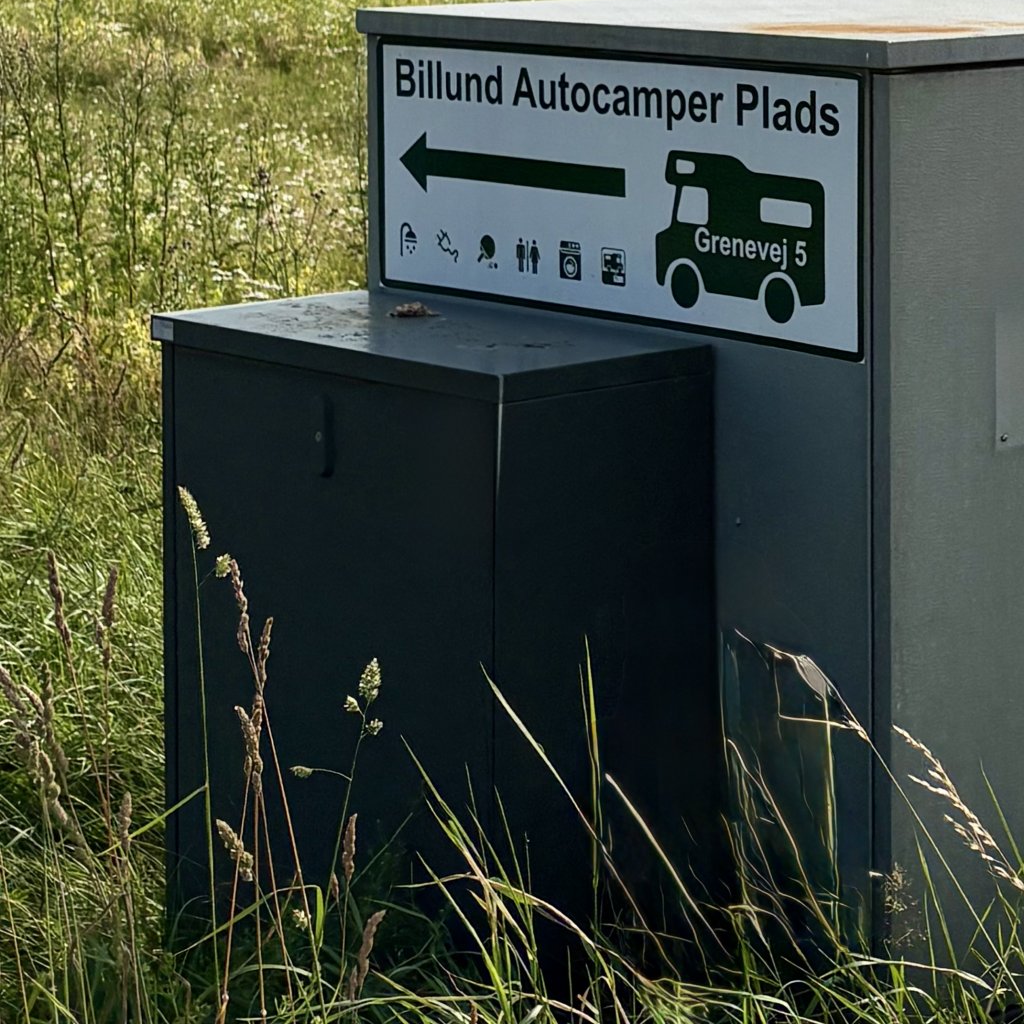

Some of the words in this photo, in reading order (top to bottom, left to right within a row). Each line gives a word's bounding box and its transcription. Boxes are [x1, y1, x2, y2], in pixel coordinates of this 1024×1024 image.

[396, 58, 503, 105] Billund
[512, 67, 724, 131] Autocamper
[735, 83, 841, 137] Plads
[694, 226, 789, 270] Grenevej
[795, 240, 807, 267] 5
